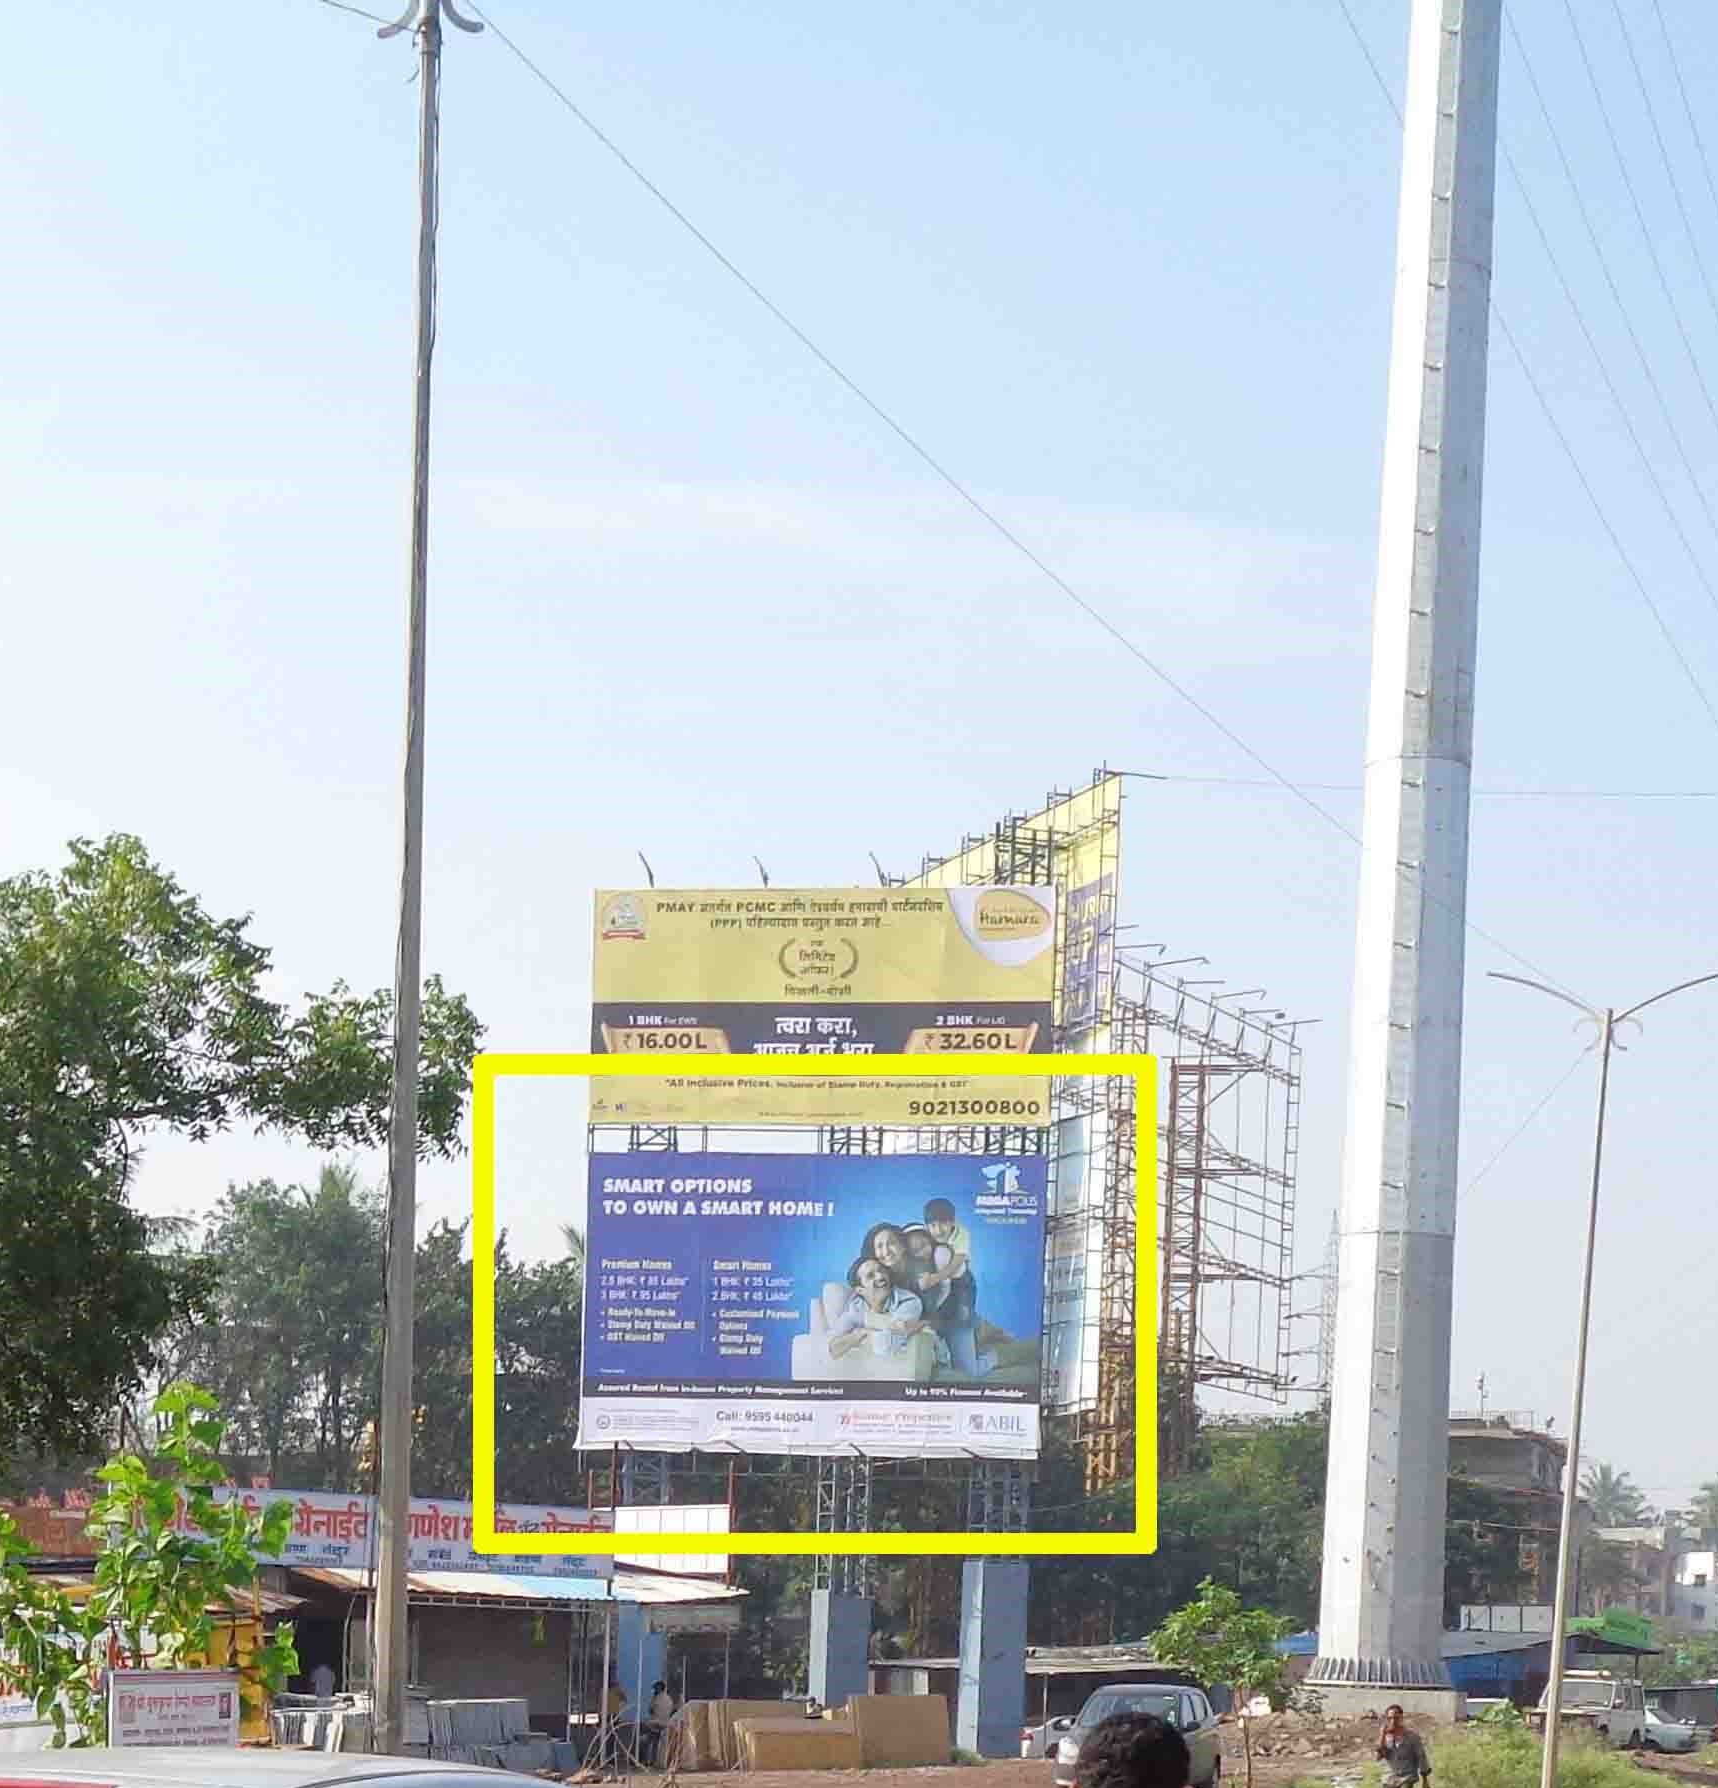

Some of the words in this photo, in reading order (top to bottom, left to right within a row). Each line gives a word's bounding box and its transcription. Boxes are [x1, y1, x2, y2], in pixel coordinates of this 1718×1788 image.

[657, 902, 695, 913] PMAY
[736, 902, 776, 913] PCMC
[636, 1015, 663, 1026] BHK
[935, 1015, 942, 1026] 2
[942, 1015, 973, 1026] BHK
[686, 1078, 734, 1089] Inclusive
[908, 1100, 1041, 1116] 9021300800
[602, 1178, 666, 1194] SMART
[670, 1178, 753, 1194] OPTIONS
[602, 1199, 628, 1216] TO
[632, 1199, 679, 1216] OWN
[682, 1200, 698, 1216] A
[700, 1200, 764, 1217] SMART
[768, 1201, 824, 1217] HOME
[715, 1410, 742, 1422] Call:
